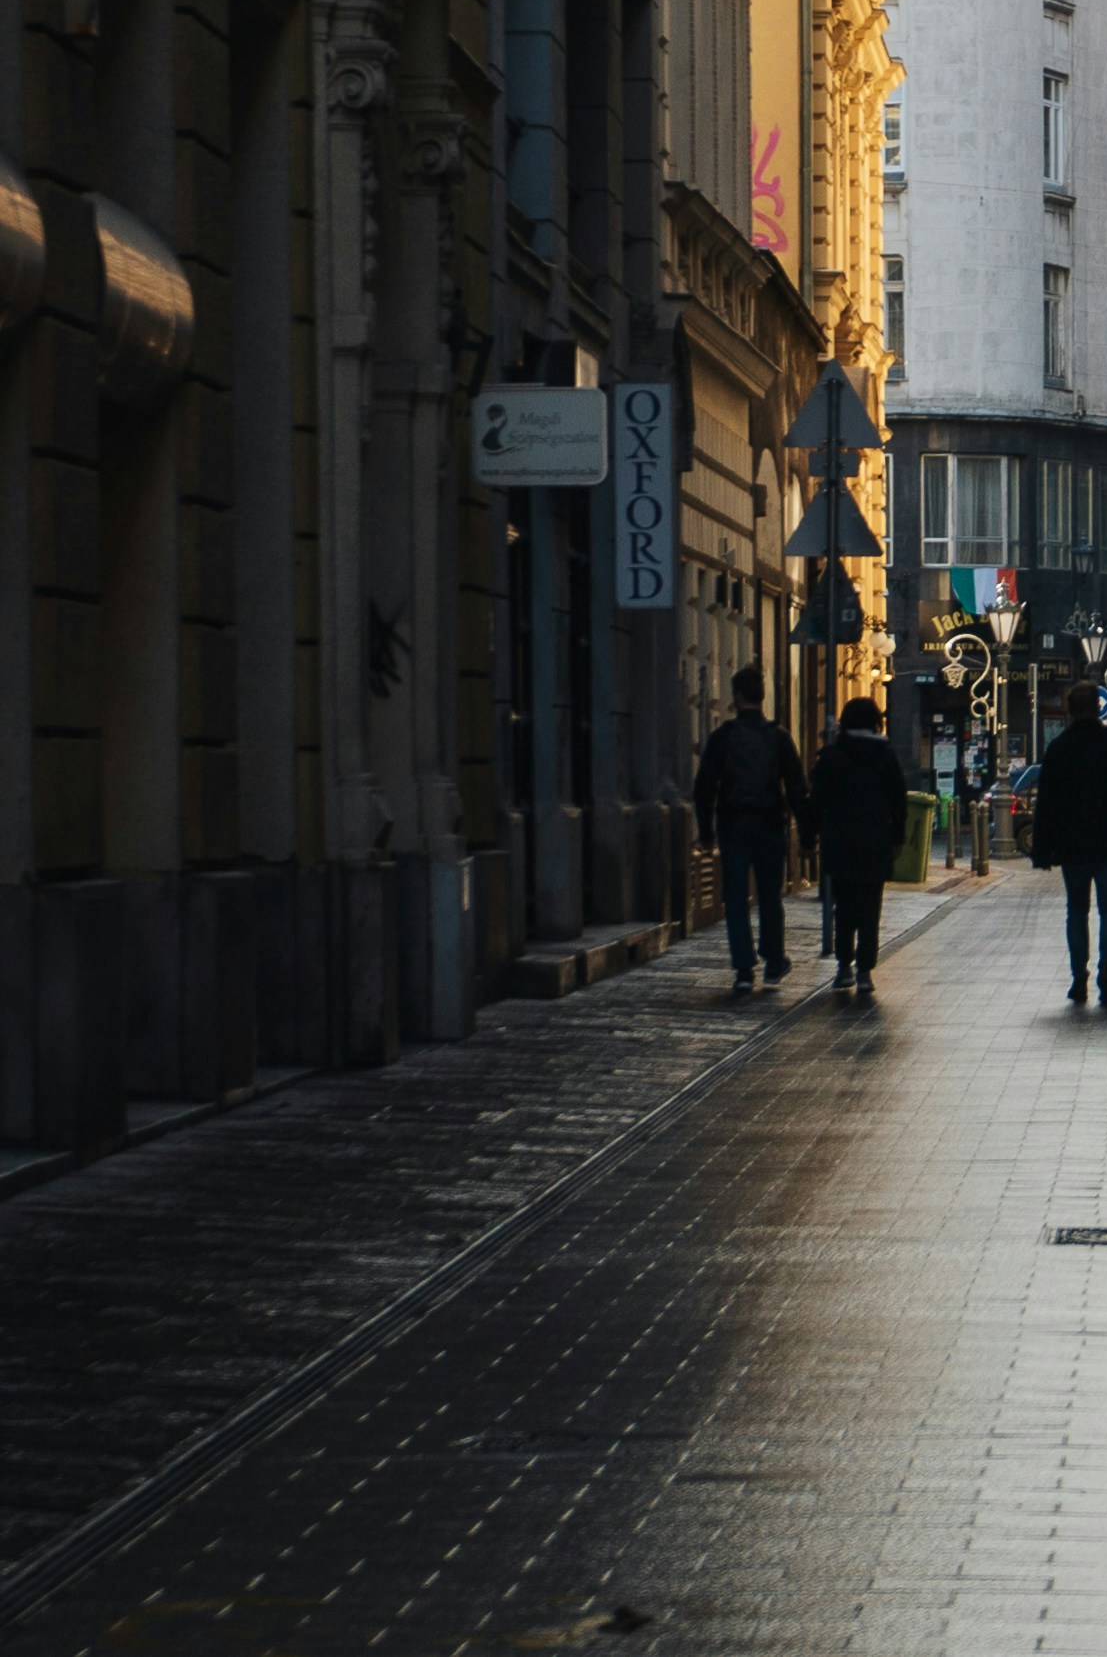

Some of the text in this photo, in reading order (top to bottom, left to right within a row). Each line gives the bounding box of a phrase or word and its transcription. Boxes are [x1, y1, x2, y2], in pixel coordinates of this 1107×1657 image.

[519, 412, 561, 429] Magdi
[625, 389, 663, 600] OXFORD
[931, 607, 975, 637] Jack
